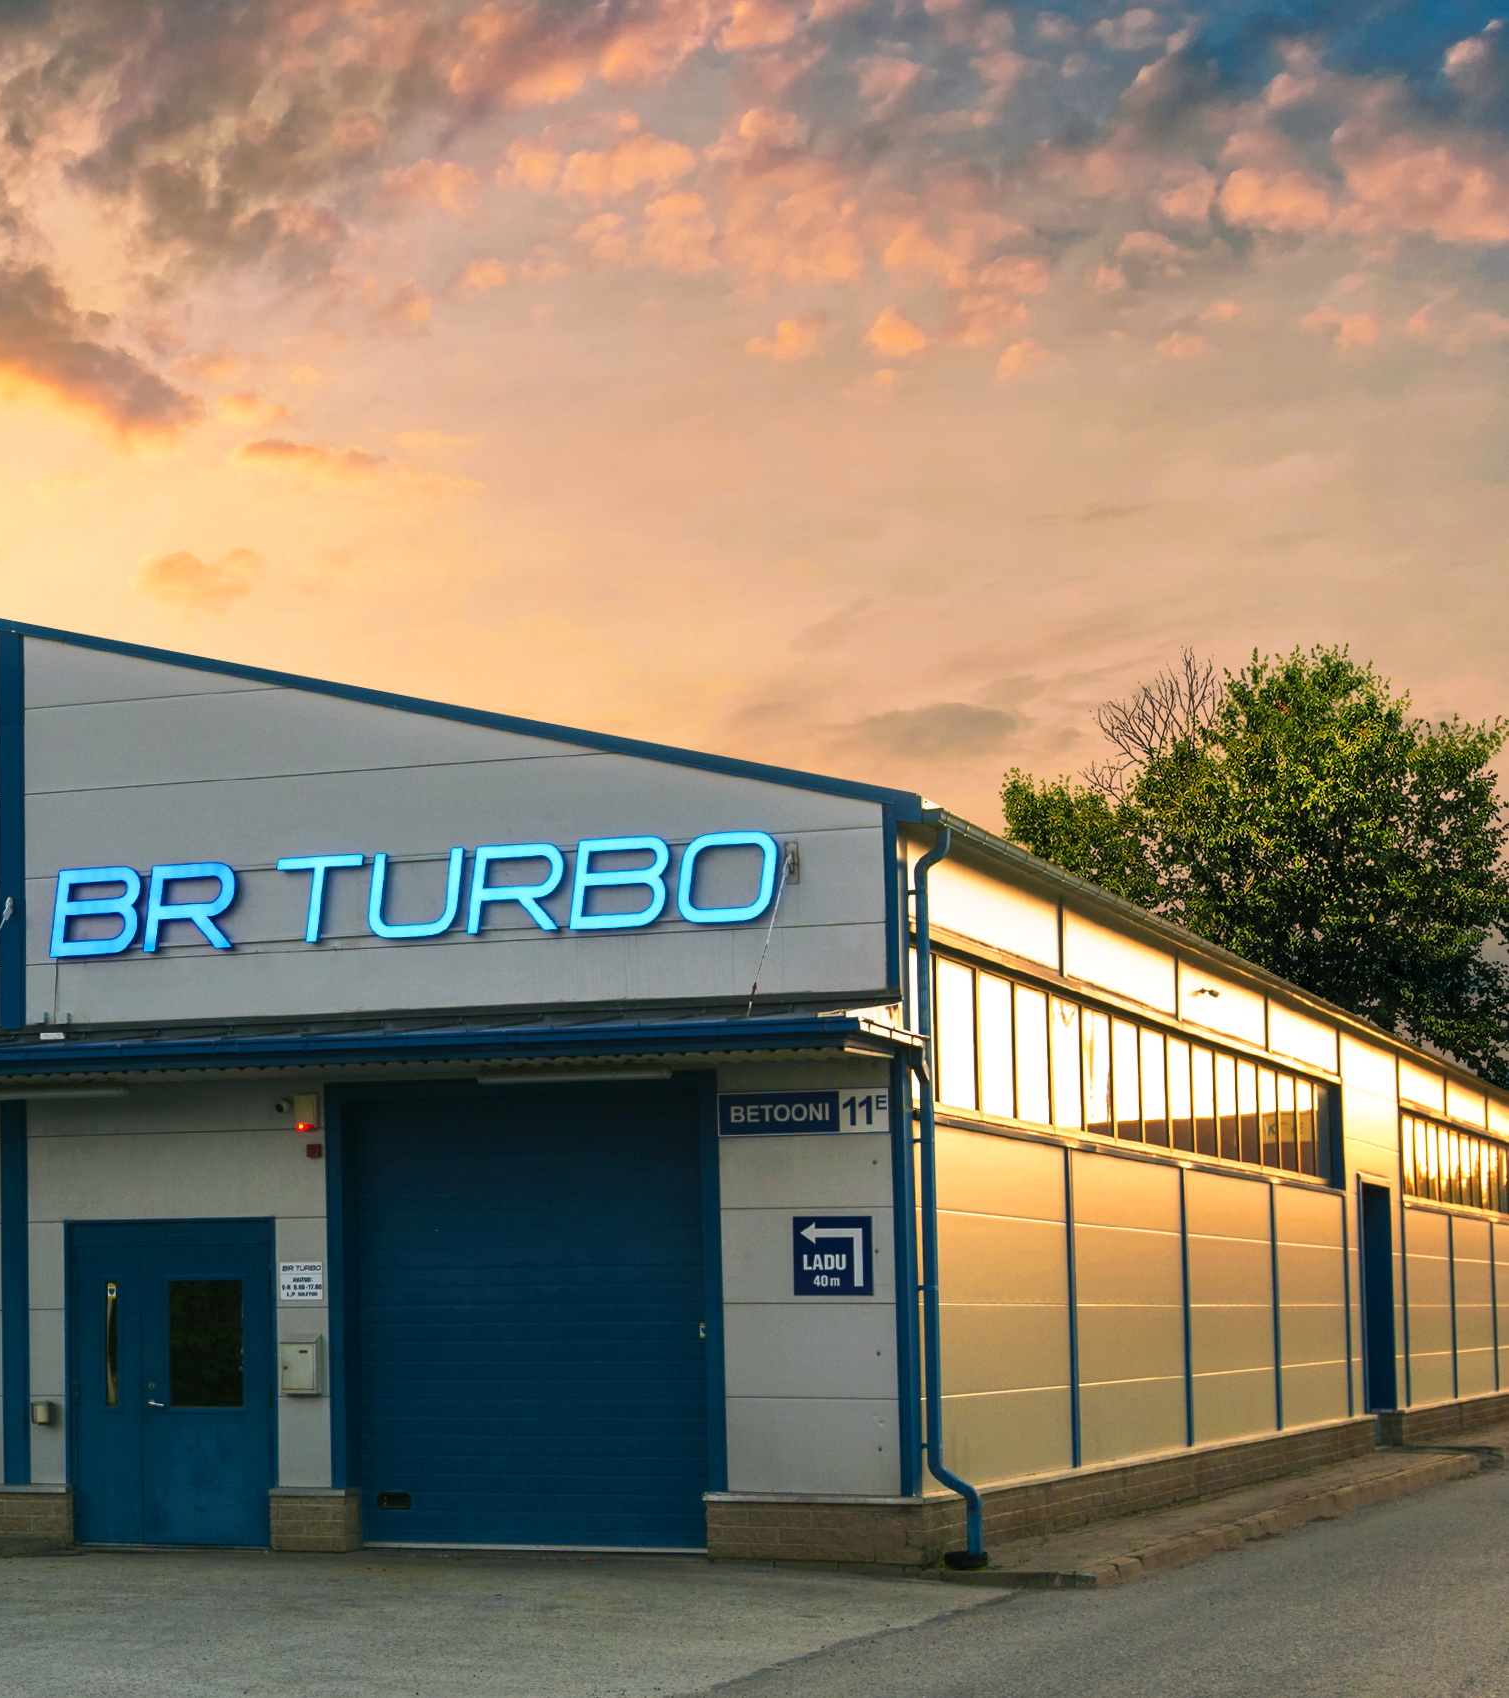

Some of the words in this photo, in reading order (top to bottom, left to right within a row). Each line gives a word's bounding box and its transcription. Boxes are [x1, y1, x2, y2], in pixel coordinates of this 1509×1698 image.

[50, 860, 236, 958] BR
[277, 831, 780, 942] TURBO
[730, 1103, 830, 1123] BETOONI
[803, 1254, 847, 1271] LADU
[813, 1275, 828, 1287] 40
